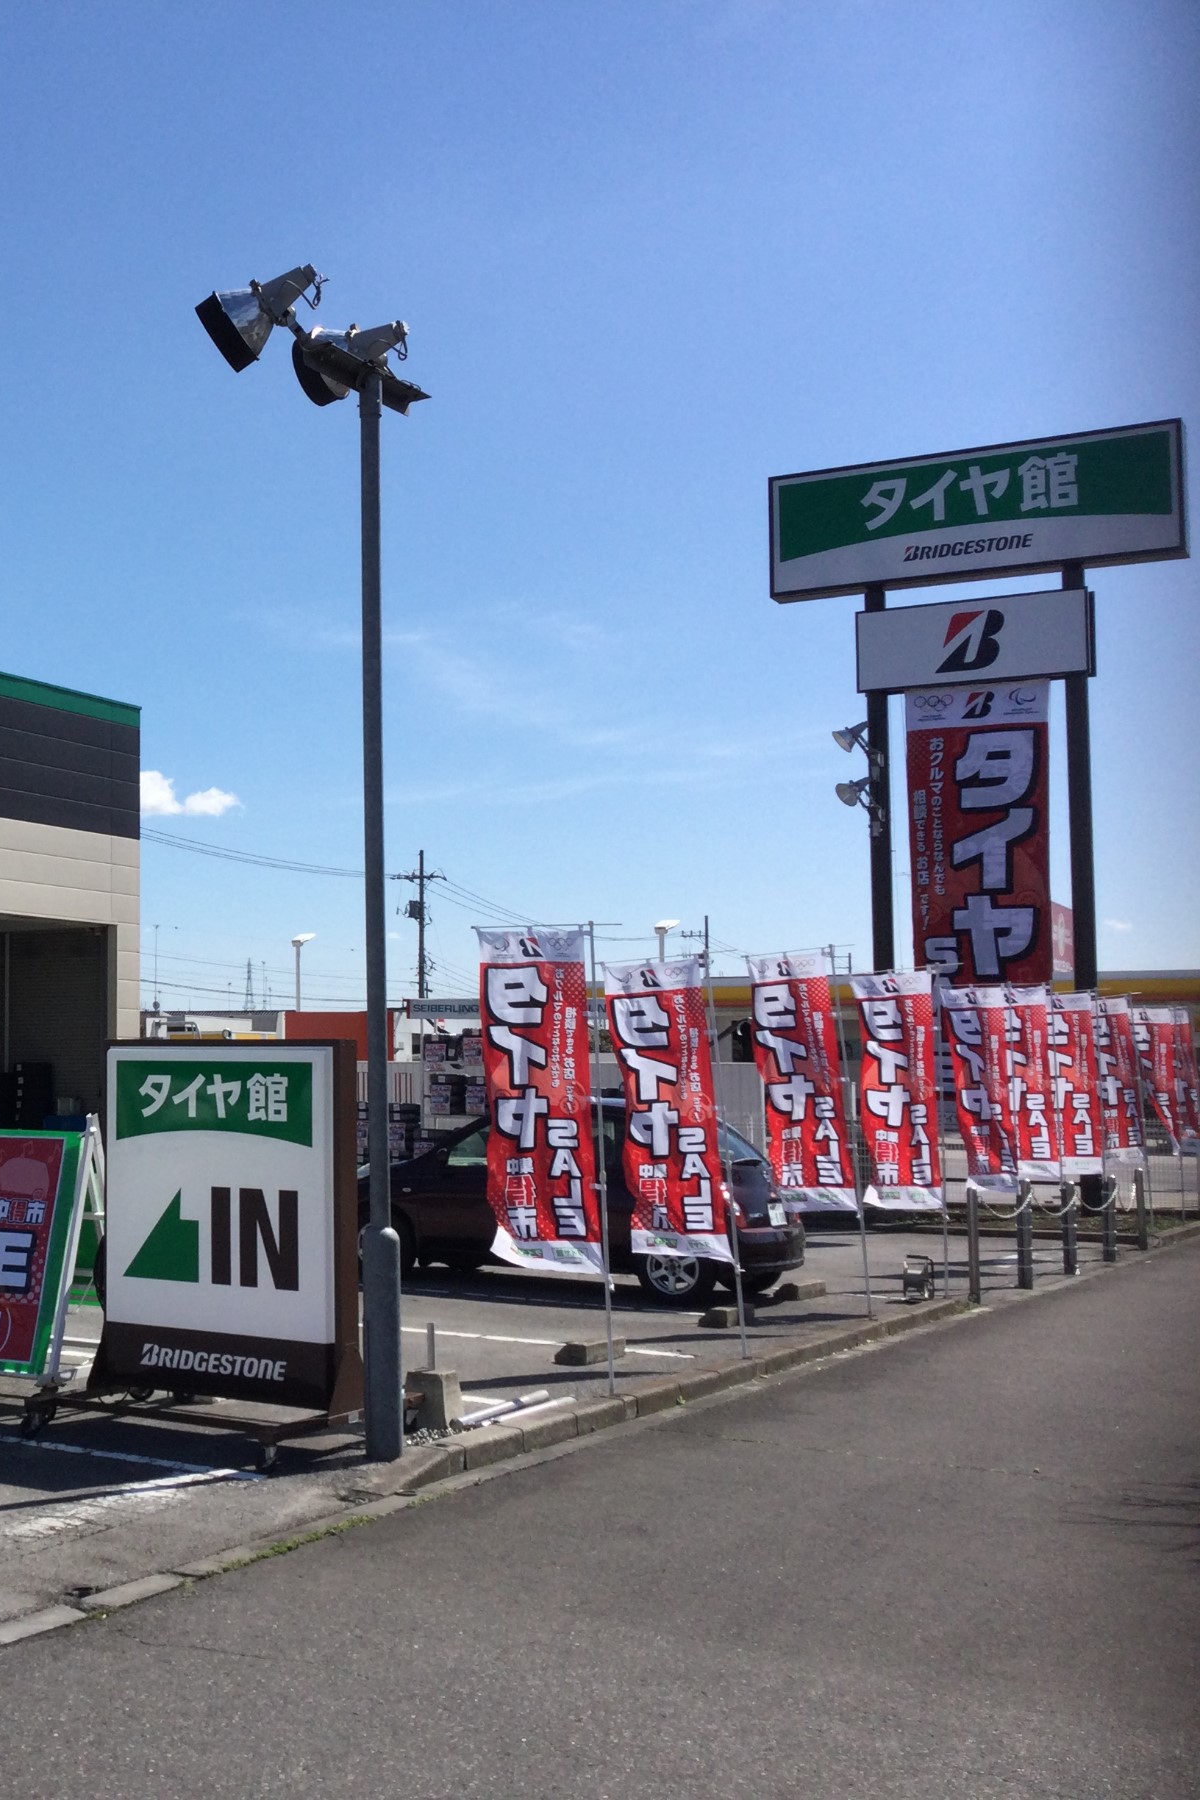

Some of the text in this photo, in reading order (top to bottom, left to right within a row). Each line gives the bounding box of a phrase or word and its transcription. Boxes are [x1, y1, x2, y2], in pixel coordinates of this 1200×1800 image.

[860, 452, 1079, 531] タイヤ館
[902, 533, 1034, 562] BRIDGESTONE
[953, 729, 1034, 975] タイヤ
[413, 1003, 480, 1014] SEIBERLING
[138, 1072, 289, 1123] タイヤ館
[211, 1186, 299, 1292] IN
[140, 1343, 286, 1382] BRIDGESTONE
